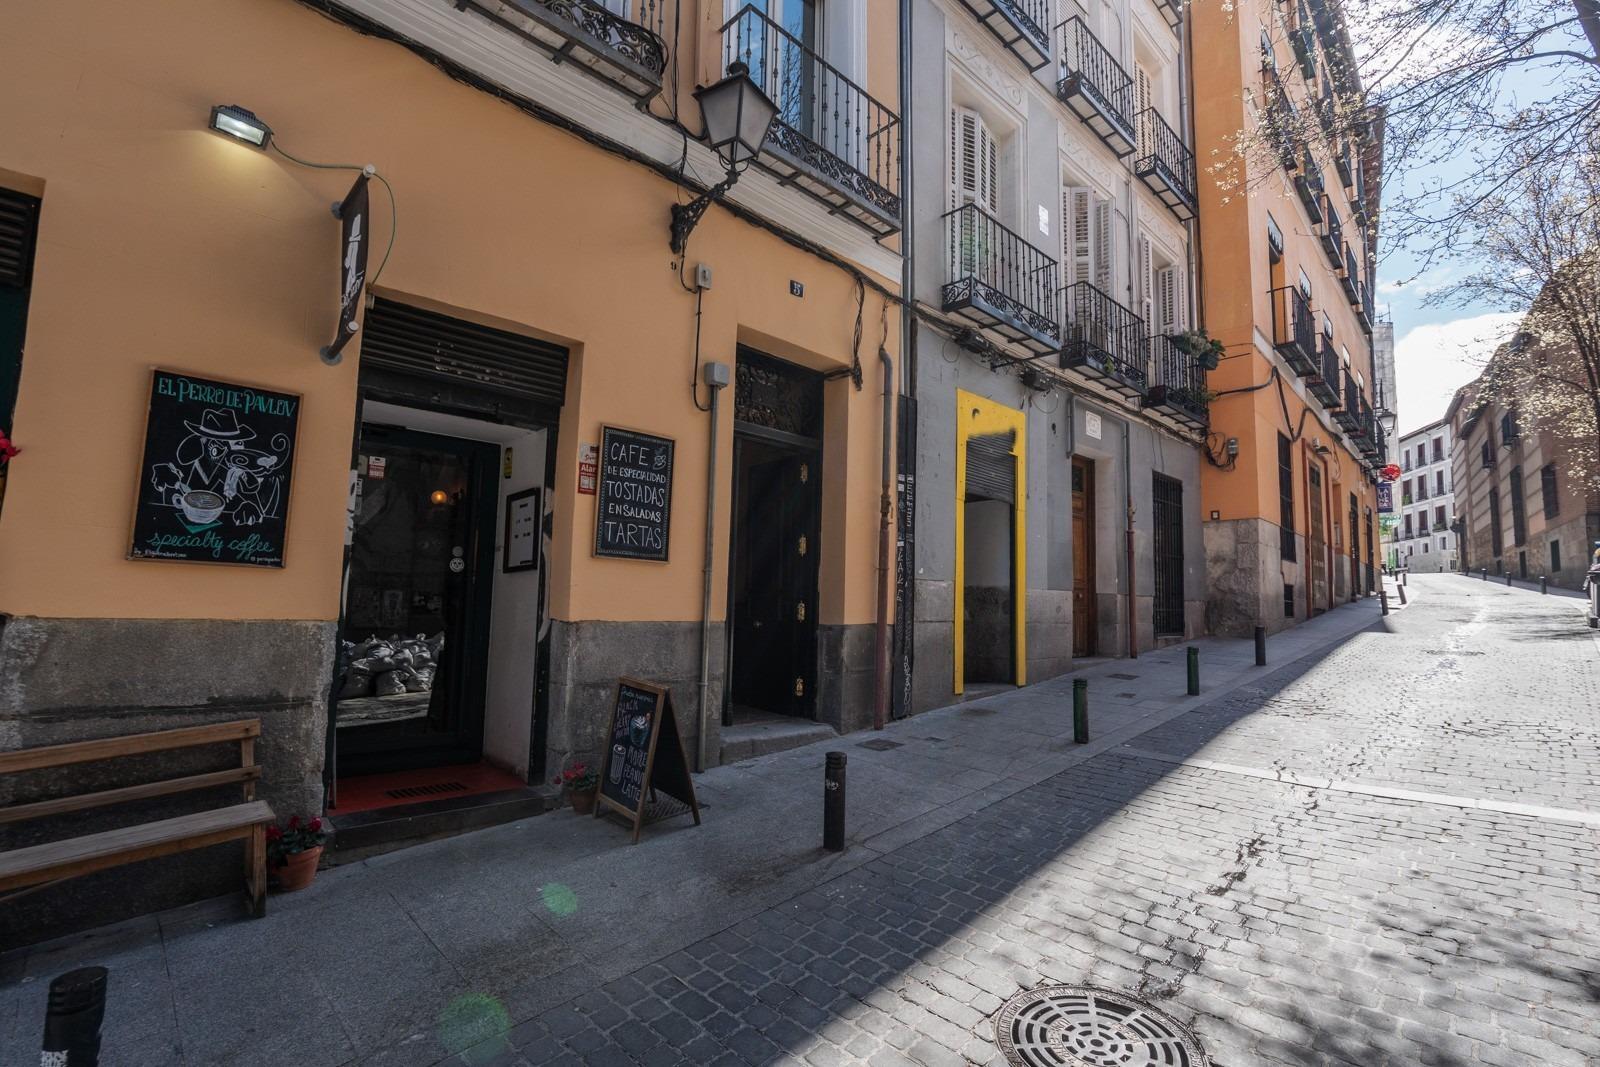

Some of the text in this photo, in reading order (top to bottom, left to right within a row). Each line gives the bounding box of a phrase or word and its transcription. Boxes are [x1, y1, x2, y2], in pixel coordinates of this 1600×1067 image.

[158, 377, 296, 417] EL PERRO DE PAVLOV
[610, 442, 650, 467] CAFE
[607, 466, 666, 483] DE ESPECIALIDAD
[606, 480, 665, 508] TOSTADAS
[608, 503, 662, 523] ENSALADAS
[147, 530, 274, 561] specialty coffee
[605, 521, 662, 549] TARTAS
